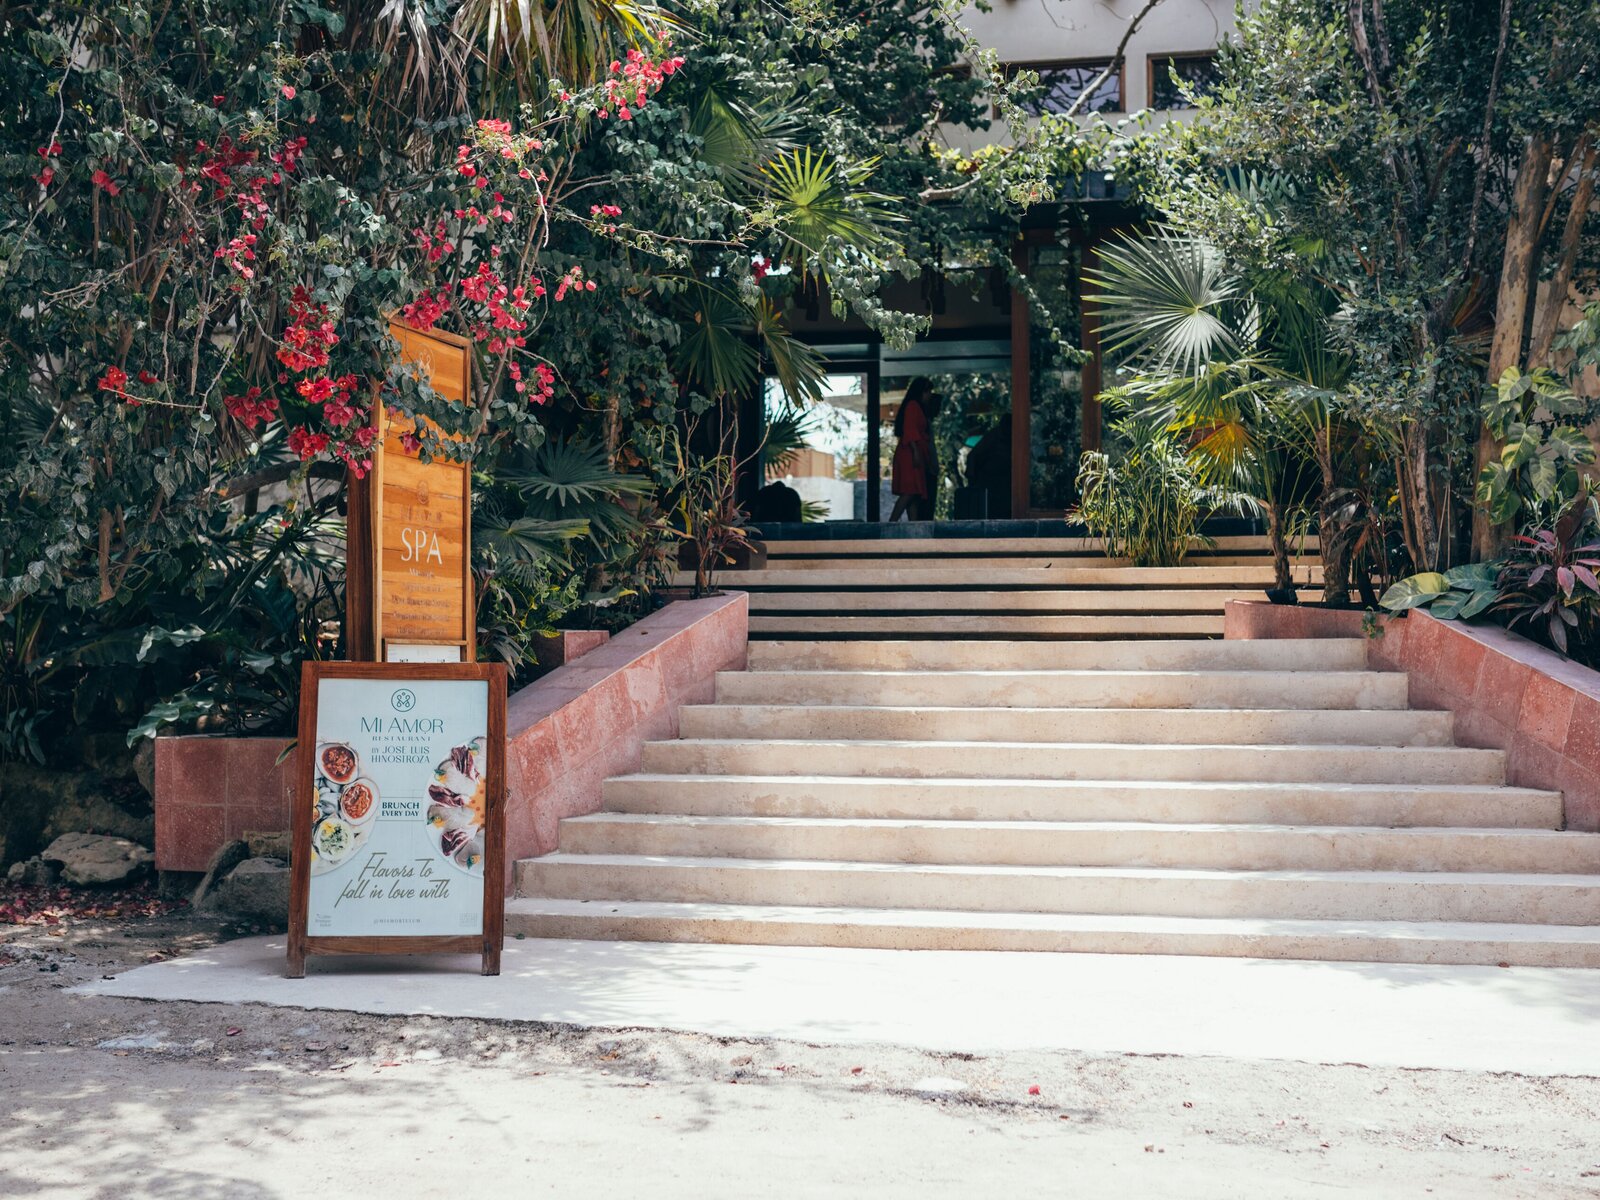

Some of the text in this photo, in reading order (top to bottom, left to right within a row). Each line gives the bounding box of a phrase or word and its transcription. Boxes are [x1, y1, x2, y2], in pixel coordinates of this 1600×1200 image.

[401, 527, 443, 565] SPA
[360, 717, 444, 734] MI AMOR
[410, 746, 430, 754] LUIS
[371, 755, 430, 764] HINOSTROZA
[382, 802, 420, 810] BRUNCH
[357, 852, 414, 881] Flavors
[334, 879, 451, 908] fall in love with
